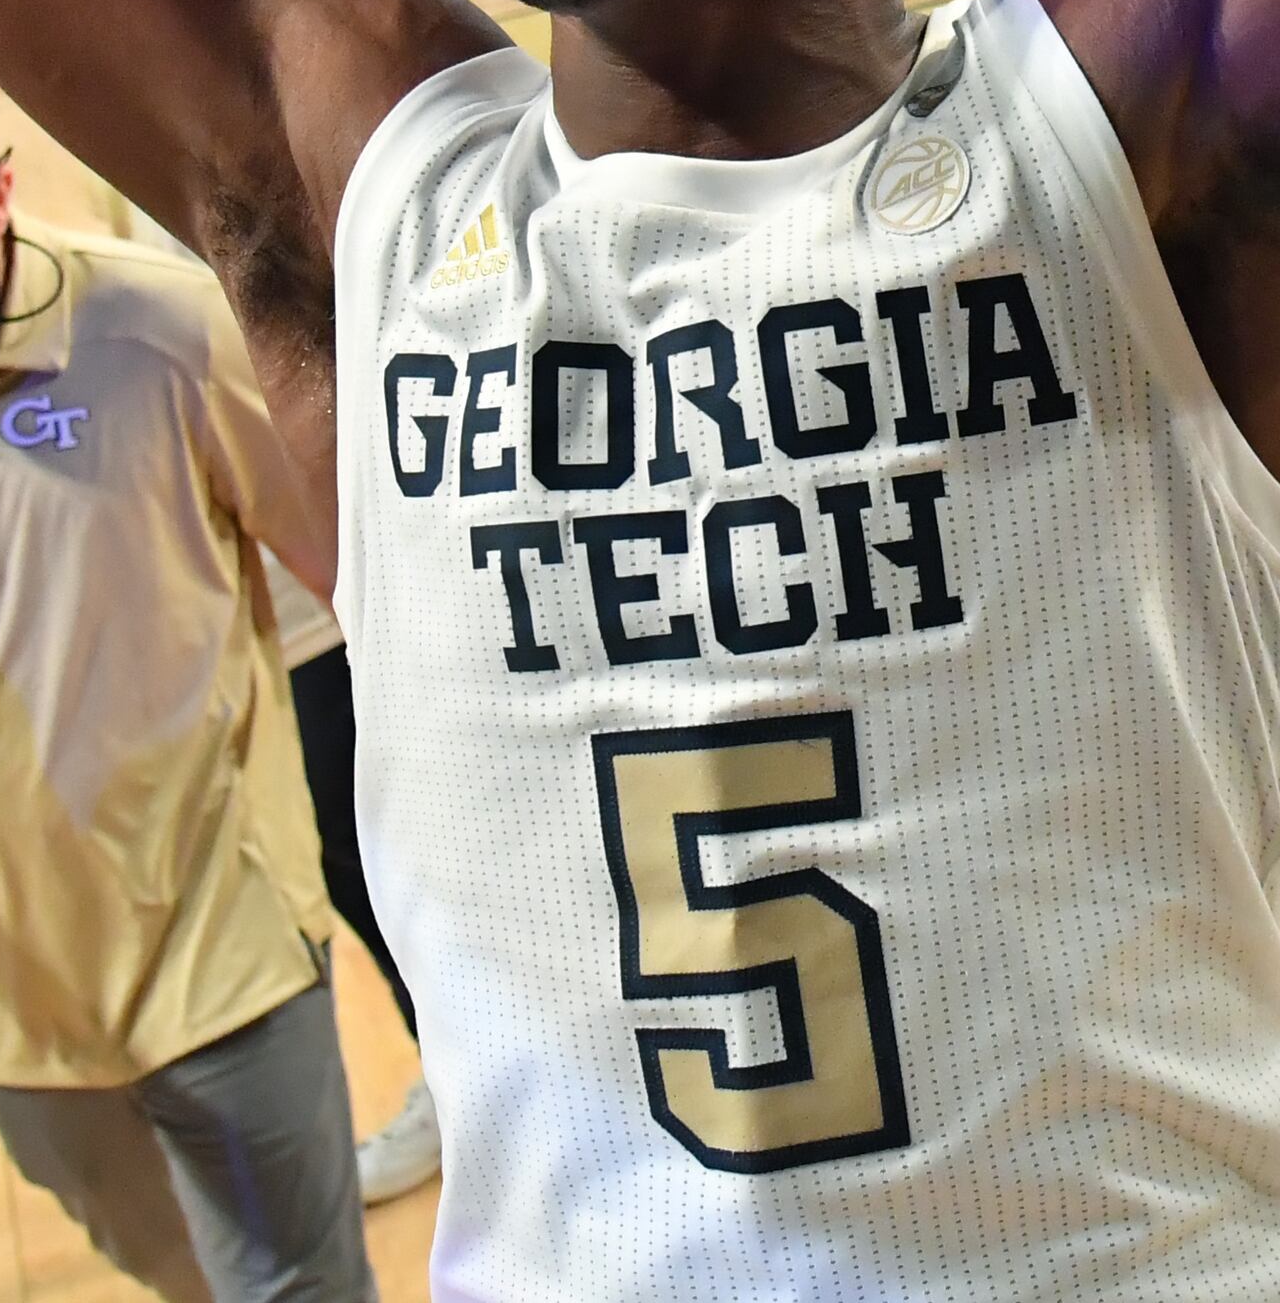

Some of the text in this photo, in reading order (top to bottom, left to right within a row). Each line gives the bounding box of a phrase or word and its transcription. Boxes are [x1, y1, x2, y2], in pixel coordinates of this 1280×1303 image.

[431, 250, 511, 289] adidas
[0, 396, 90, 451] GT
[384, 273, 1078, 498] GEORGIA
[470, 470, 965, 673] TECH
[590, 709, 912, 1175] 5
